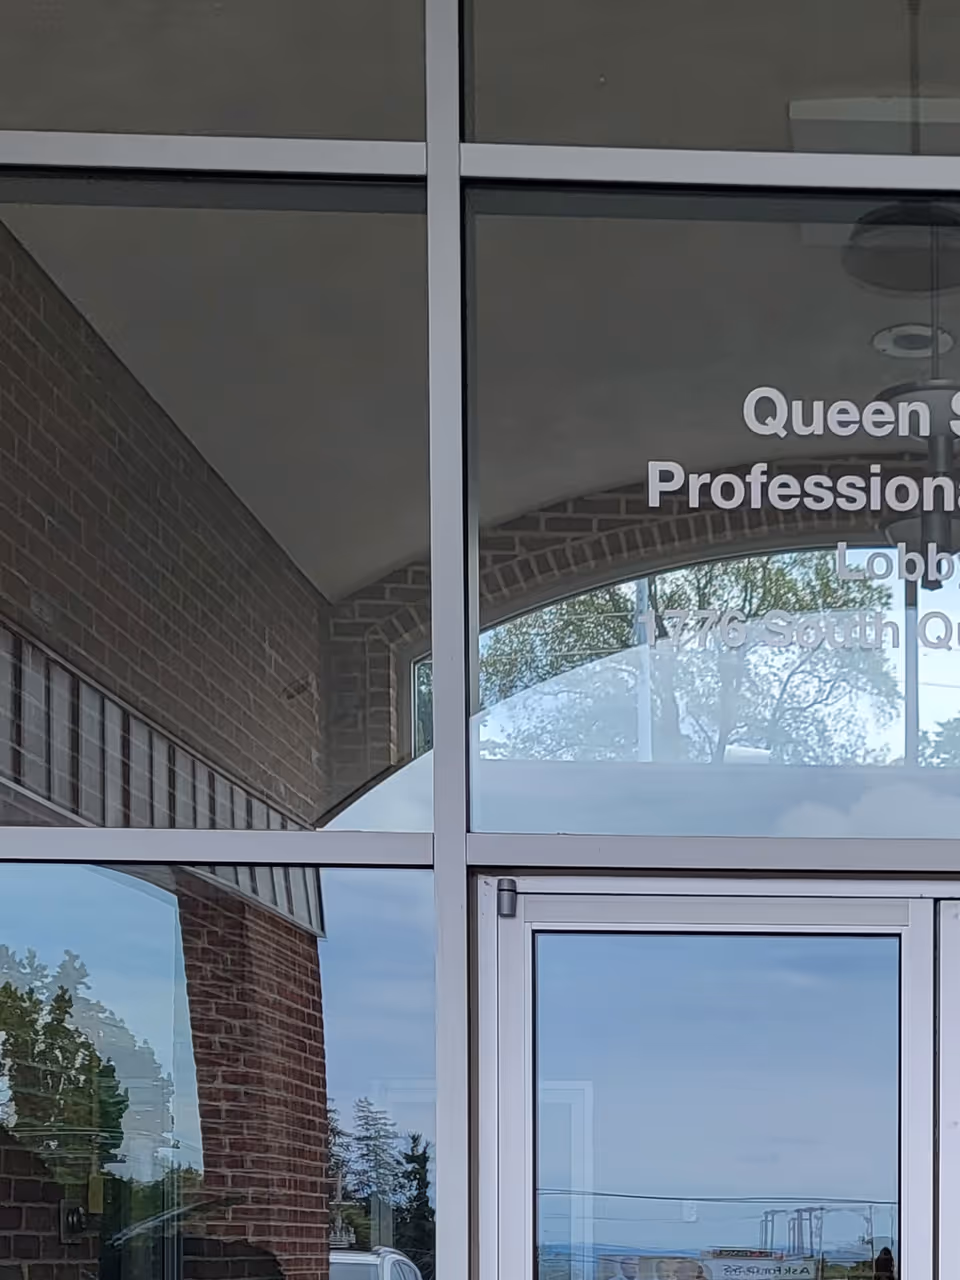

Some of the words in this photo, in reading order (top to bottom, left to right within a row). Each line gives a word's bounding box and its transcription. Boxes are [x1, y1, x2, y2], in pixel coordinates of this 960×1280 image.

[743, 387, 930, 439] Queen
[638, 609, 748, 649] 1776
[762, 609, 900, 650] South
